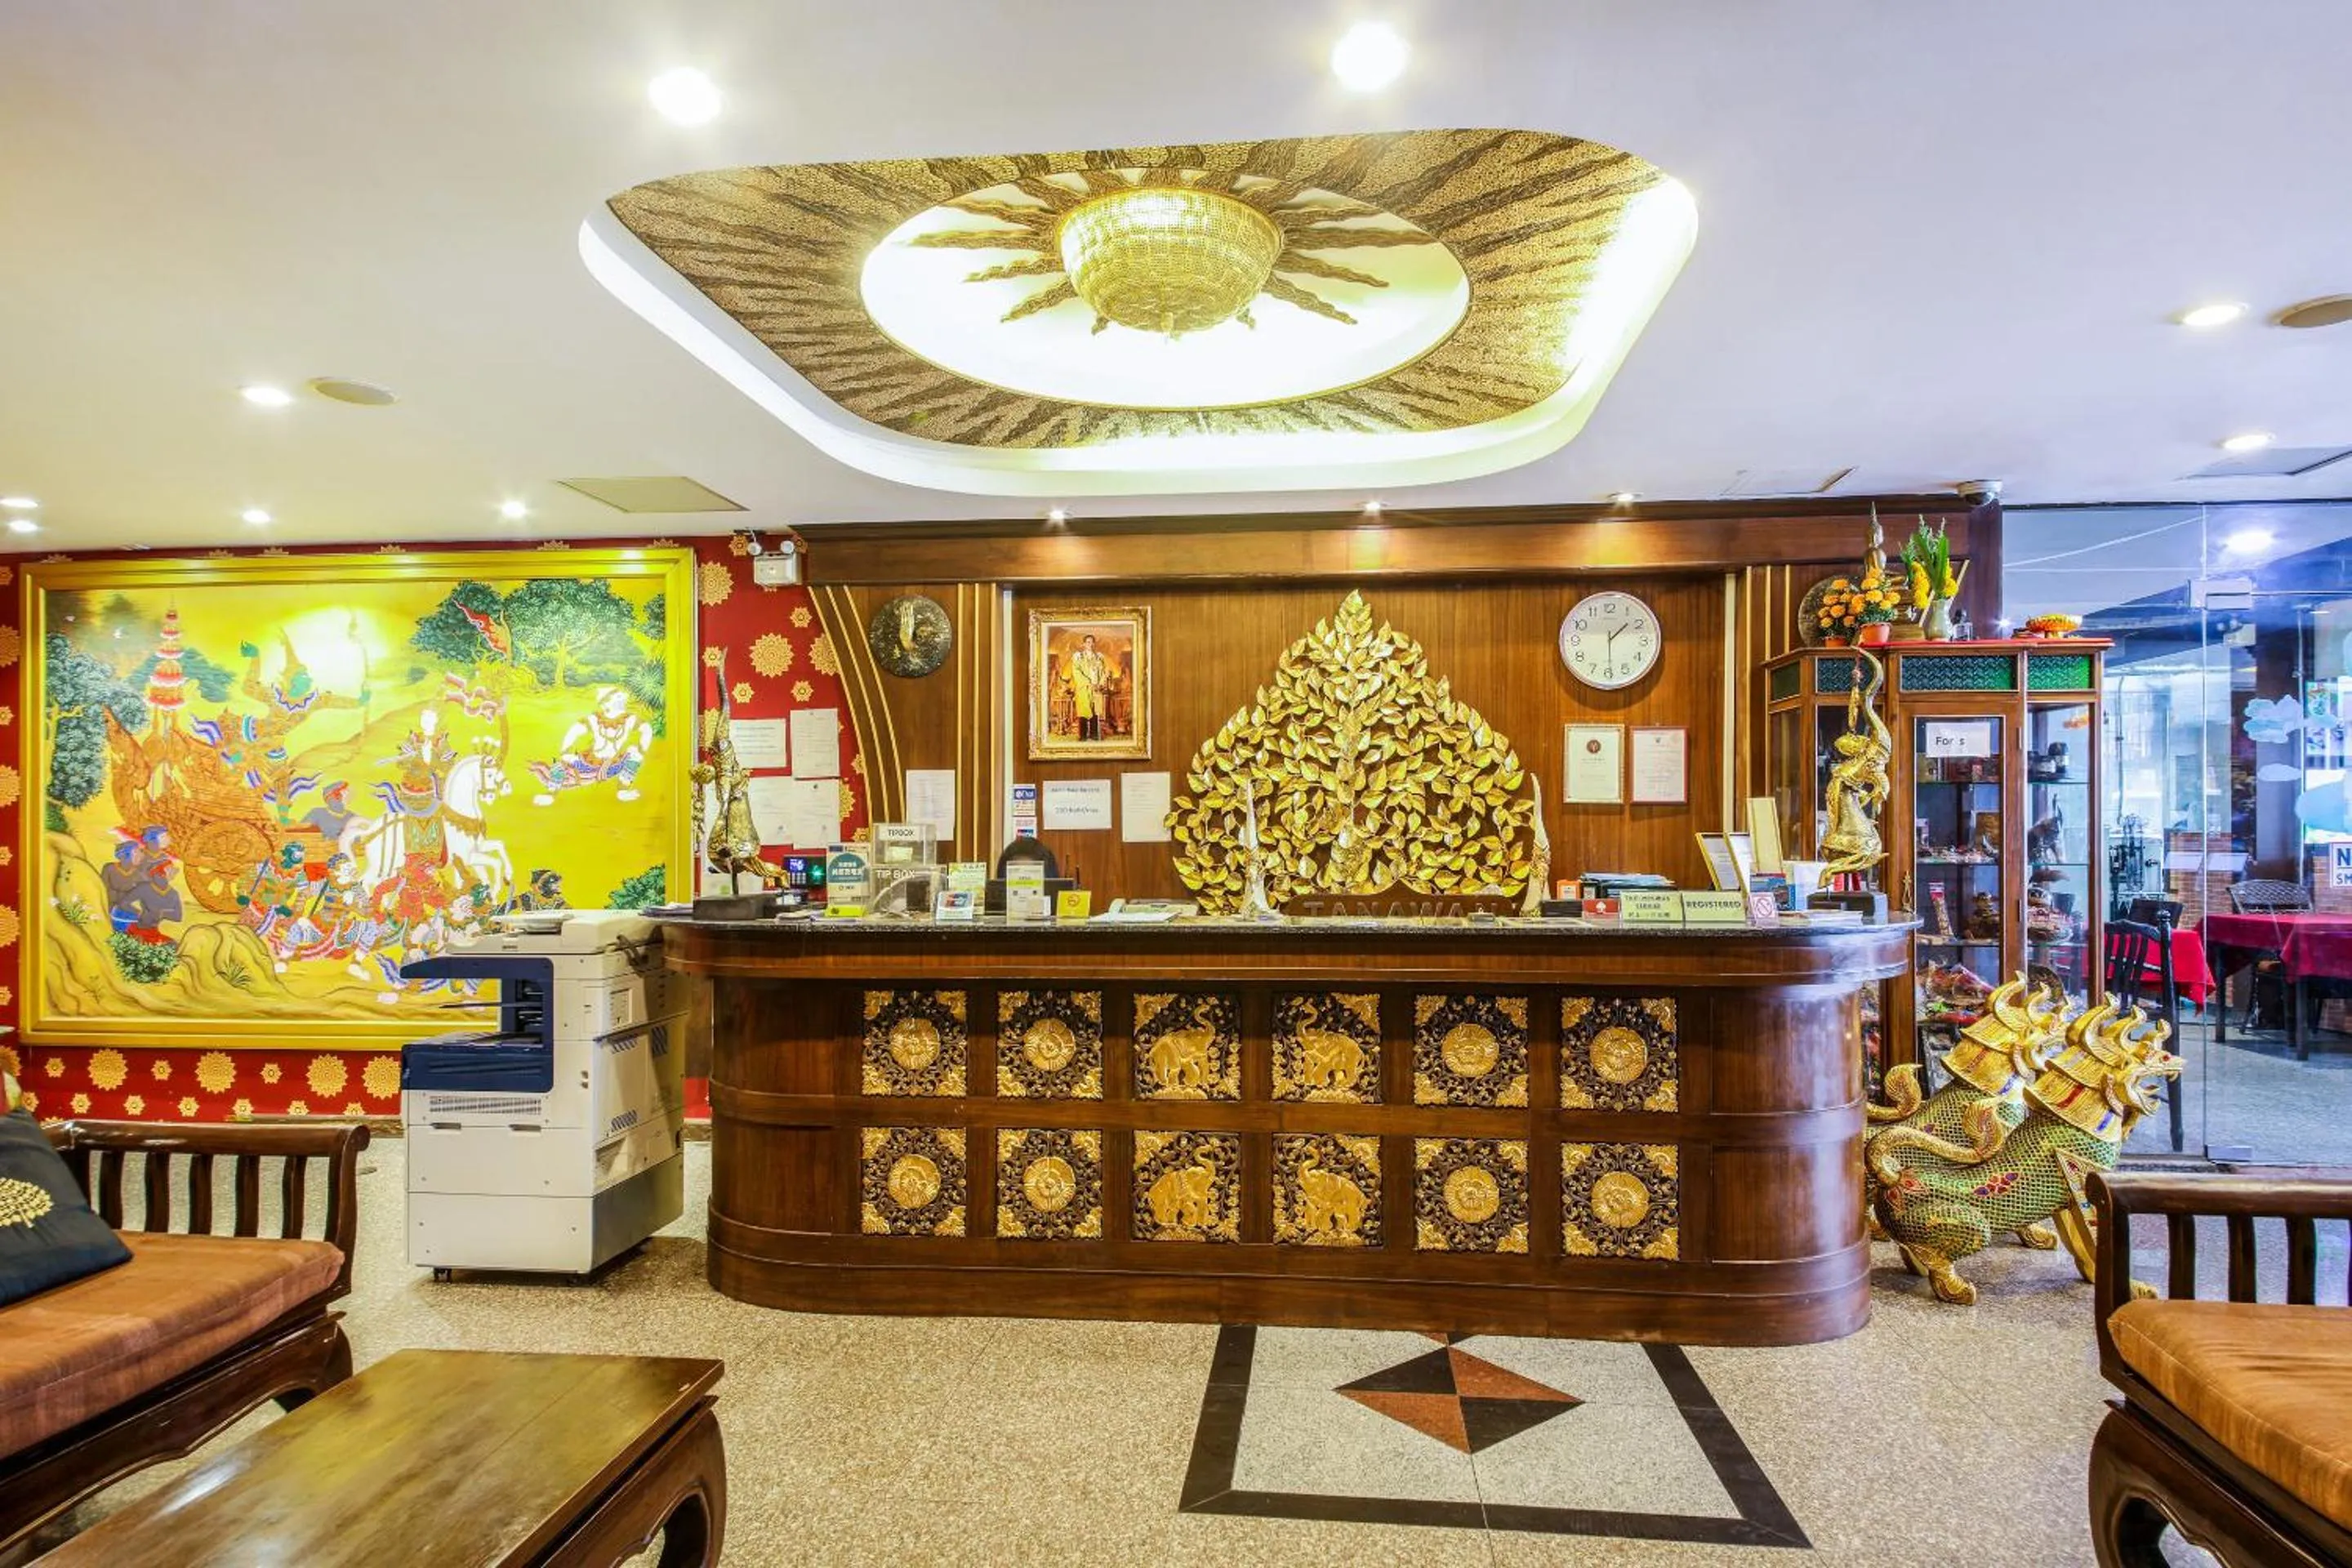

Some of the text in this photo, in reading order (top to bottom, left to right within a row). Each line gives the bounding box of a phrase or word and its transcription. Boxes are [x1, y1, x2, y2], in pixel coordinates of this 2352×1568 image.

[1588, 607, 1597, 617] 11
[1604, 604, 1615, 613] 12
[1574, 620, 1587, 630] 10
[1634, 619, 1644, 629] 2
[1571, 635, 1580, 646] 9
[1639, 636, 1648, 646] 3
[1575, 652, 1584, 662] 8
[1588, 663, 1597, 674] 7
[1603, 667, 1614, 679] 6
[1620, 663, 1629, 675] 5
[1936, 737, 1953, 746] For
[875, 869, 892, 879] TIP
[893, 869, 915, 879] BOX
[1686, 901, 1741, 909] REGISTERED
